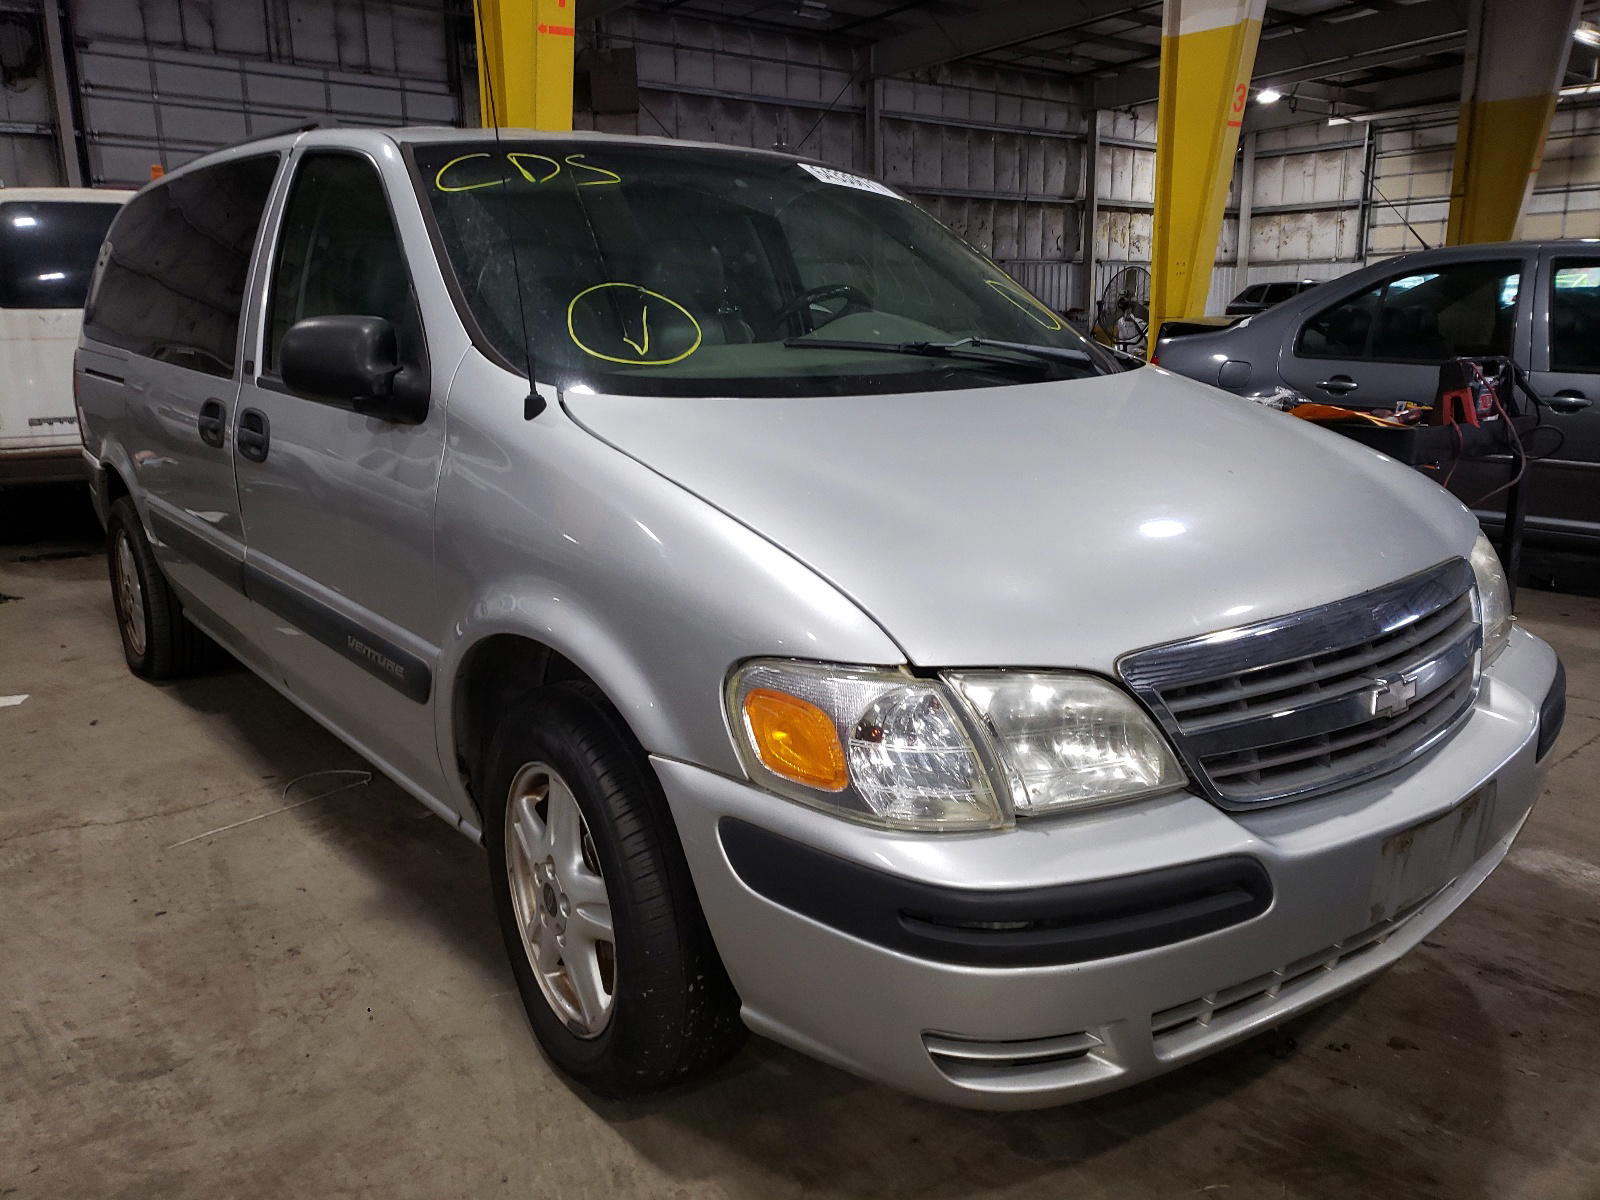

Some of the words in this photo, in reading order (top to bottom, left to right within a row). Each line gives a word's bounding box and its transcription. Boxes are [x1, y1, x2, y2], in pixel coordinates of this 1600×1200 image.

[1233, 83, 1247, 112] 3
[435, 152, 621, 192] CDS
[347, 634, 405, 679] VENTURE
